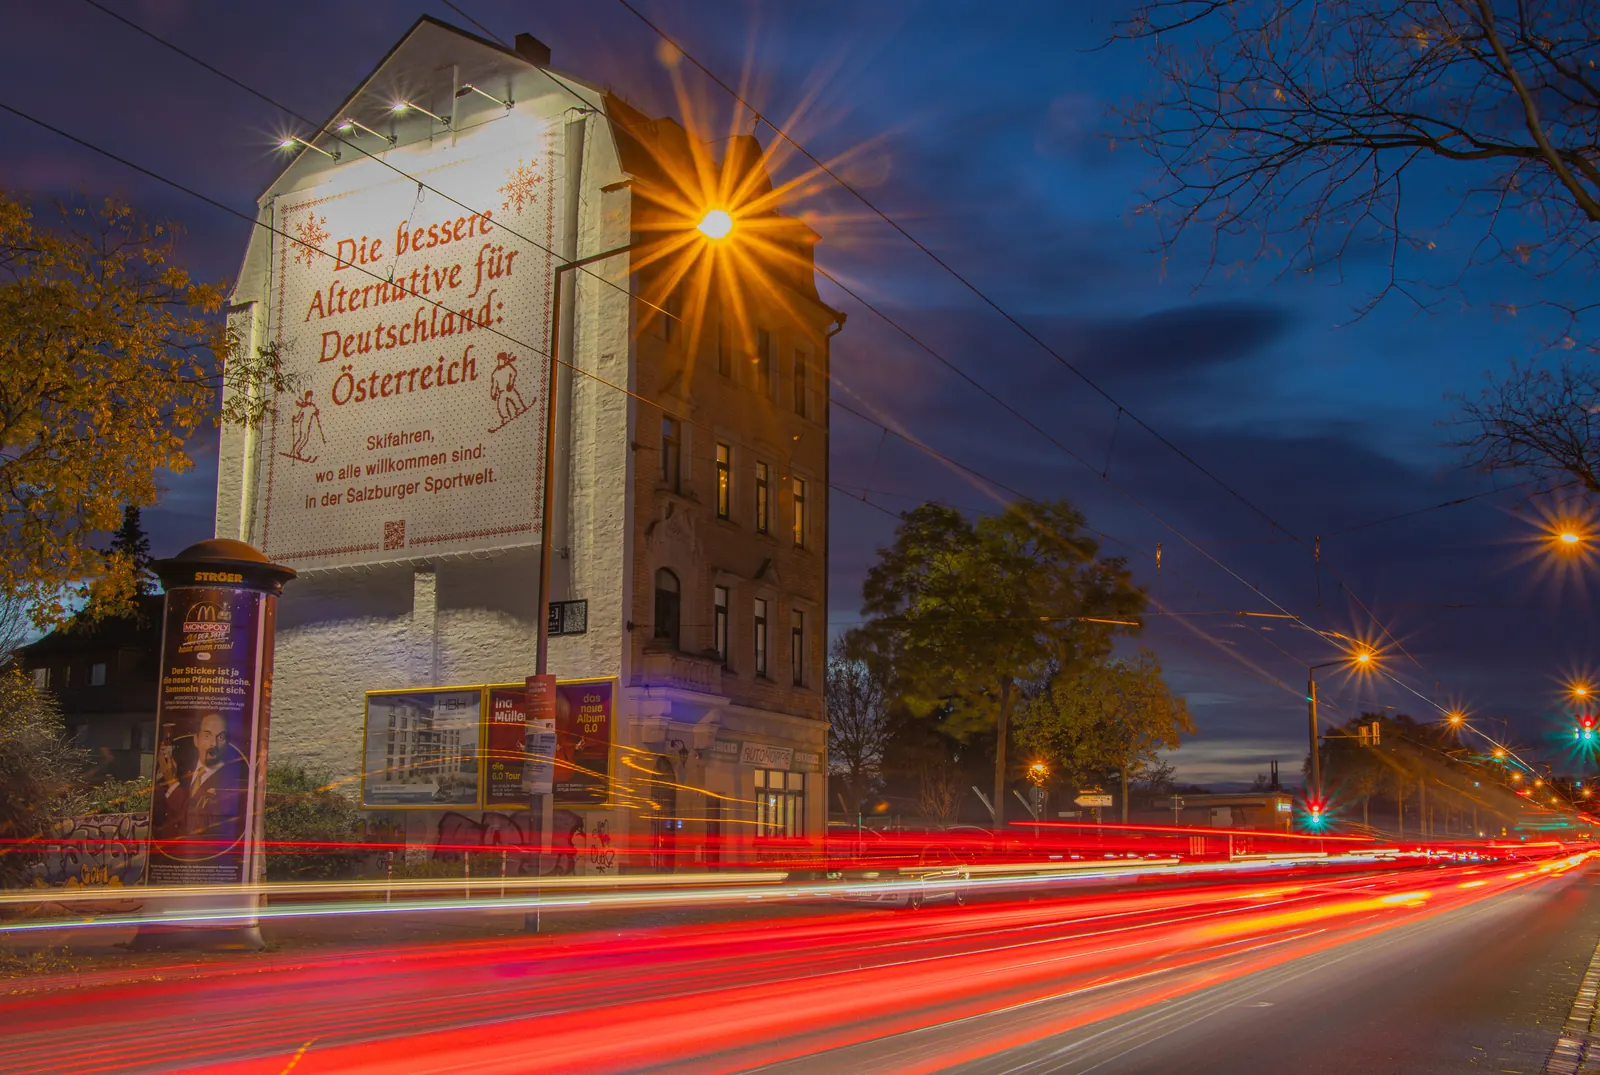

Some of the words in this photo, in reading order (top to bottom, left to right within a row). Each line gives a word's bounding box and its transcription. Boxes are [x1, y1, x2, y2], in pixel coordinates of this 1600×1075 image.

[333, 236, 383, 272] Die
[395, 210, 494, 257] bessere
[304, 262, 463, 323] Alternative
[467, 243, 520, 299] für
[318, 288, 504, 364] Deutschland:
[331, 344, 479, 407] Österreich
[366, 429, 436, 452] Skifahren,
[315, 470, 334, 484] wo
[338, 462, 361, 481] alle
[365, 450, 447, 477] willkommen
[305, 494, 317, 510] in
[321, 487, 343, 508] der
[346, 477, 421, 504] Salzburger
[423, 468, 498, 493] Sportwelt.
[194, 571, 244, 584] STRÖER
[185, 623, 229, 631] MONOPOLY
[171, 667, 185, 675] Der
[185, 666, 217, 675] Sticker
[217, 667, 230, 676] ist
[230, 667, 240, 678] ja
[163, 676, 172, 684] die
[164, 684, 199, 693] Sammeln
[200, 684, 225, 694] lohnt
[225, 686, 247, 695] sich.
[583, 692, 601, 704] das
[438, 698, 467, 711] HBH
[580, 704, 604, 714] neue
[576, 713, 607, 725] Album
[583, 723, 599, 734] 6.0
[504, 772, 521, 780] Tour
